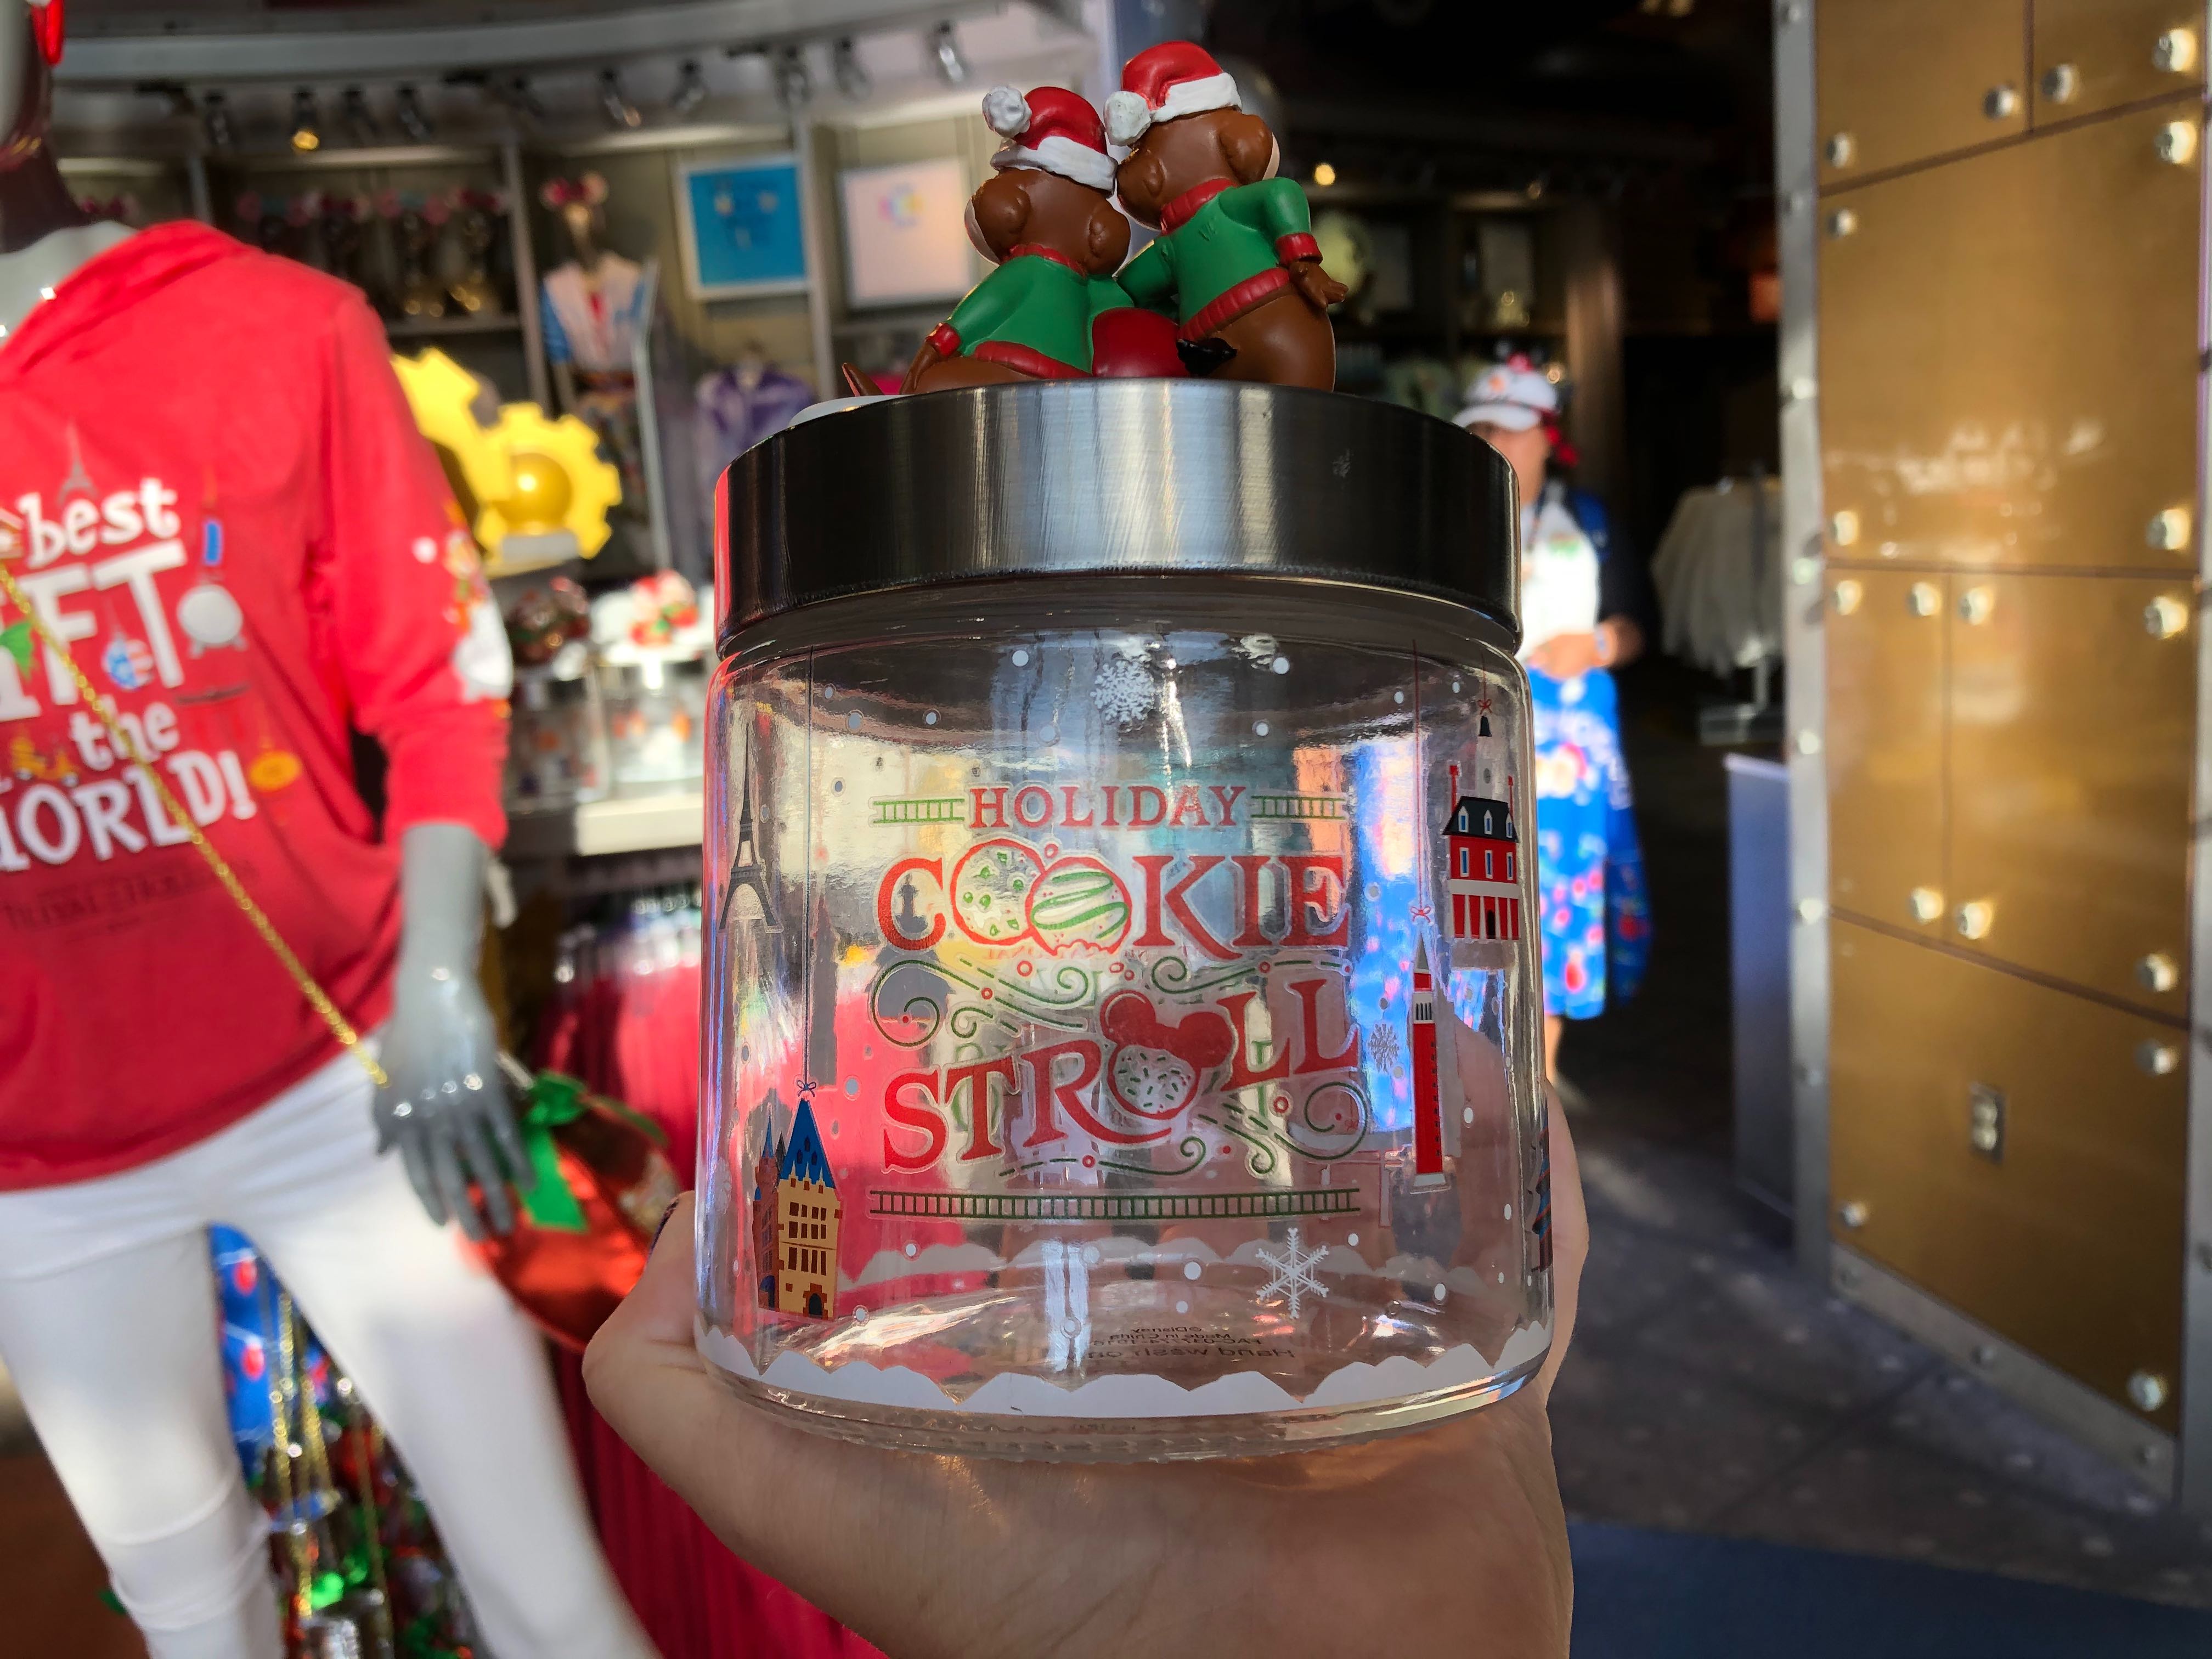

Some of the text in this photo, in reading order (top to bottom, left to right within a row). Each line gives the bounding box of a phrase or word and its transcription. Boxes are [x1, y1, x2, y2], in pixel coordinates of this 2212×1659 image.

[15, 477, 182, 569] best
[70, 695, 180, 771] the
[0, 750, 257, 872] ORLD!
[968, 785, 1246, 830] HOLIDAY
[878, 838, 1350, 960] COOKIE
[883, 979, 1359, 1173] STROLL
